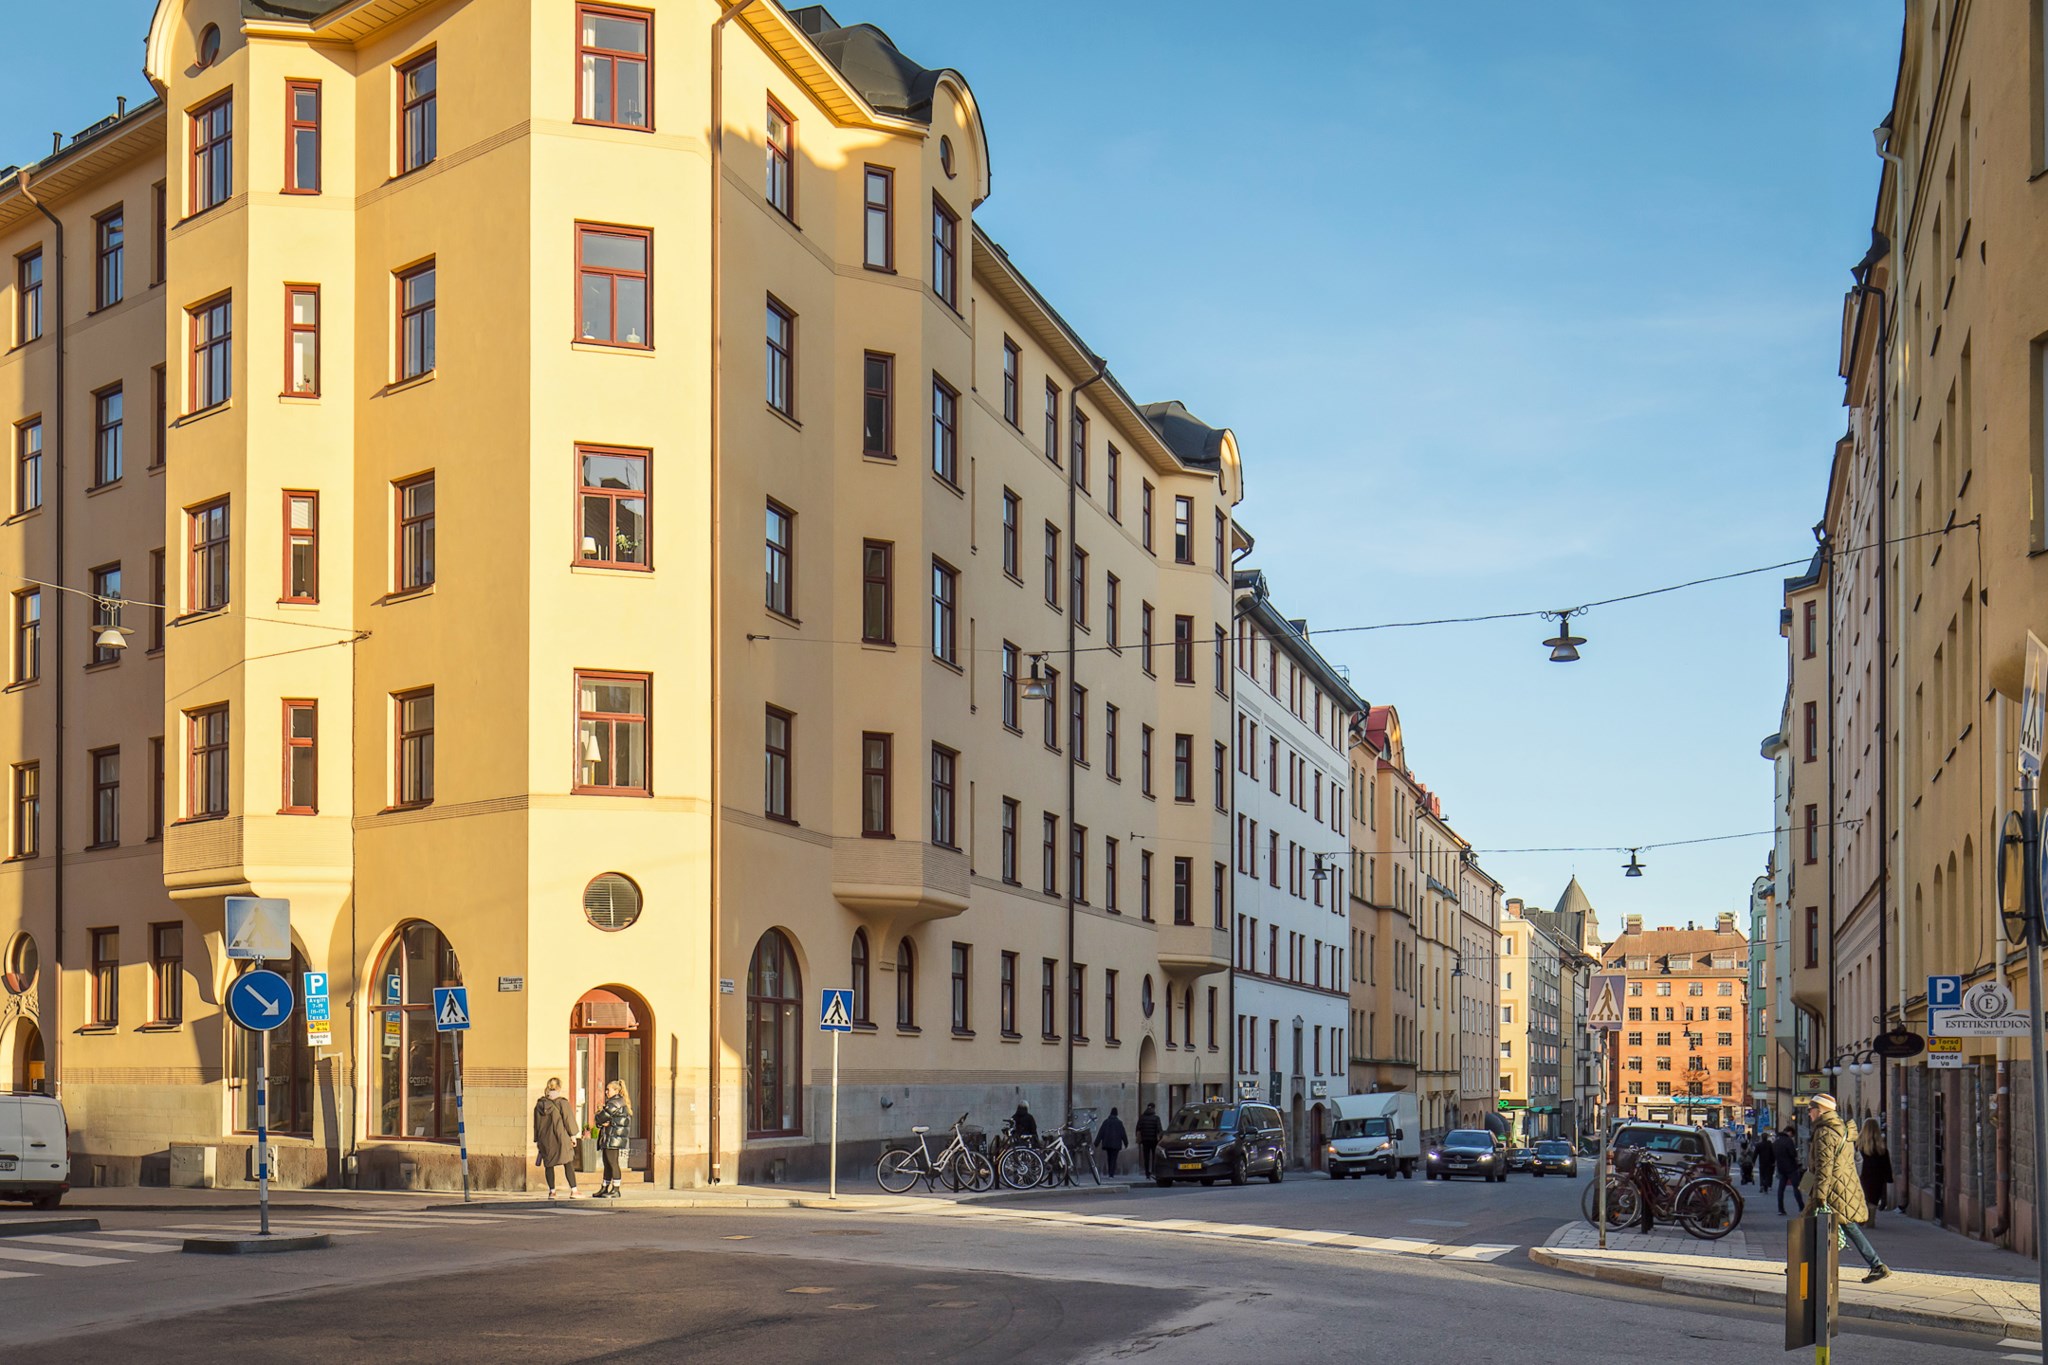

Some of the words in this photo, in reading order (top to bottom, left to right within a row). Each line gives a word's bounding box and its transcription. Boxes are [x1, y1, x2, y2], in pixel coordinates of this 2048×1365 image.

[310, 975, 324, 994] P
[1936, 979, 1955, 1003] P
[1985, 998, 1993, 1010] E
[1945, 1020, 2031, 1029] ESTETIKSTUDION
